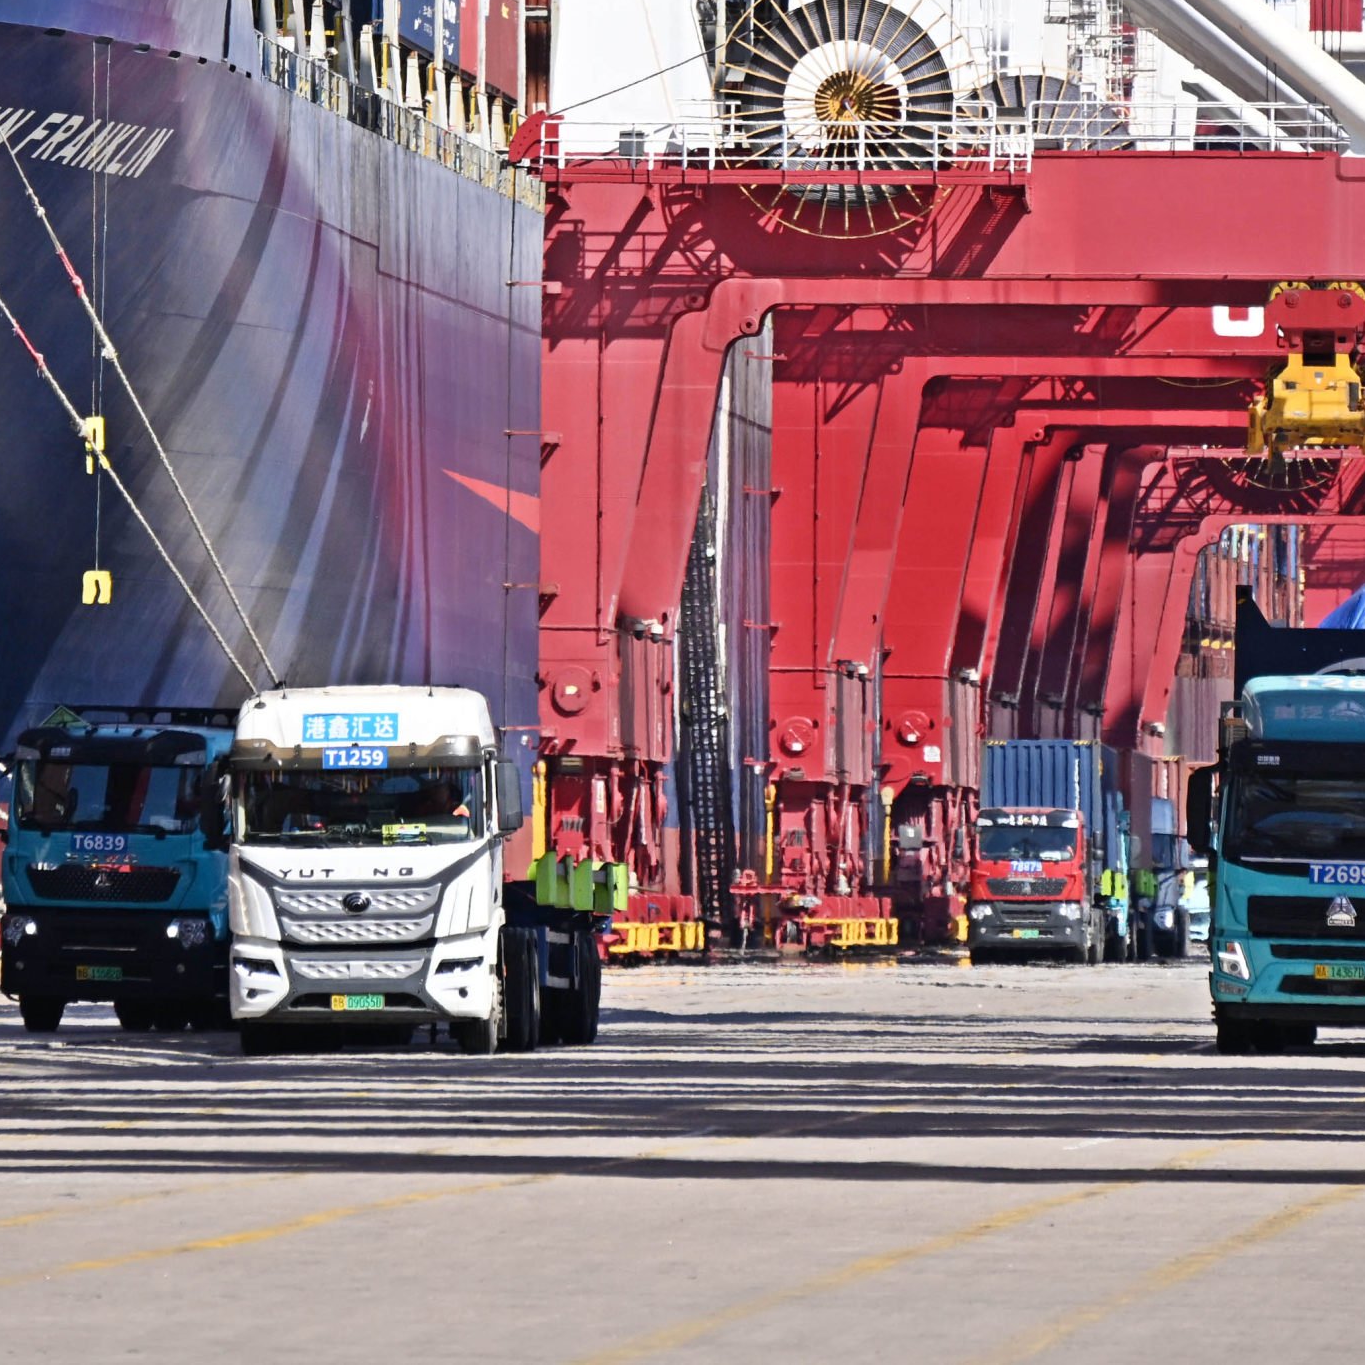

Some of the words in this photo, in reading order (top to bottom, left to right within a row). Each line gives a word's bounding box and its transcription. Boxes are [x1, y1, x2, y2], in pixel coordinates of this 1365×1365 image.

[15, 111, 175, 178] FRANKLIN
[305, 716, 395, 740] 港鑫汇达
[325, 750, 384, 766] T1259
[73, 834, 125, 851] T6839
[279, 867, 414, 879] YUTNG
